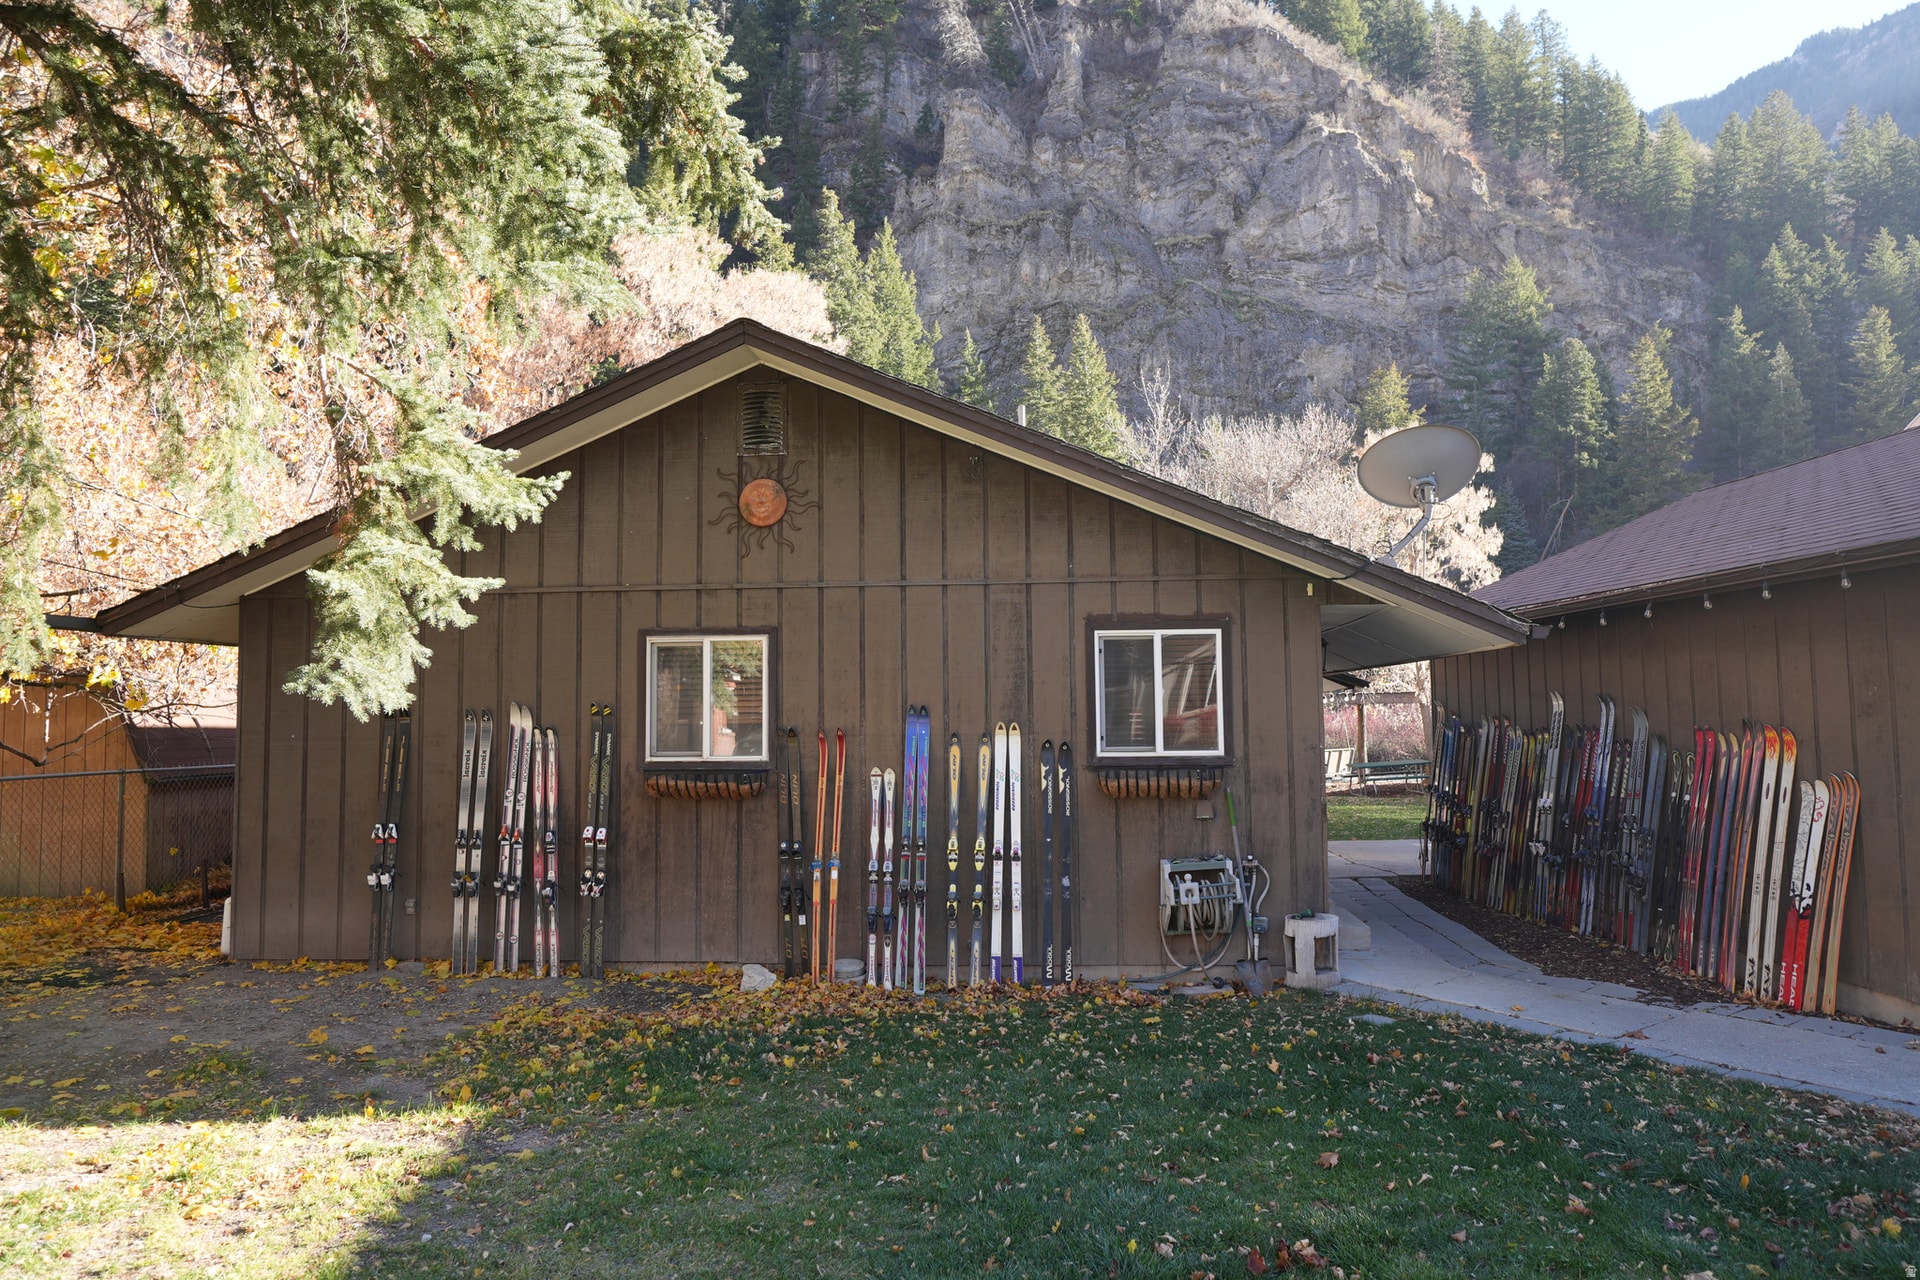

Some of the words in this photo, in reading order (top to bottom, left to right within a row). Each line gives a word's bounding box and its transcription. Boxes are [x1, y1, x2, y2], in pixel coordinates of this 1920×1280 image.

[463, 749, 472, 778] lacroix
[479, 750, 487, 778] lacroix
[1582, 741, 1591, 781] ATOMIC
